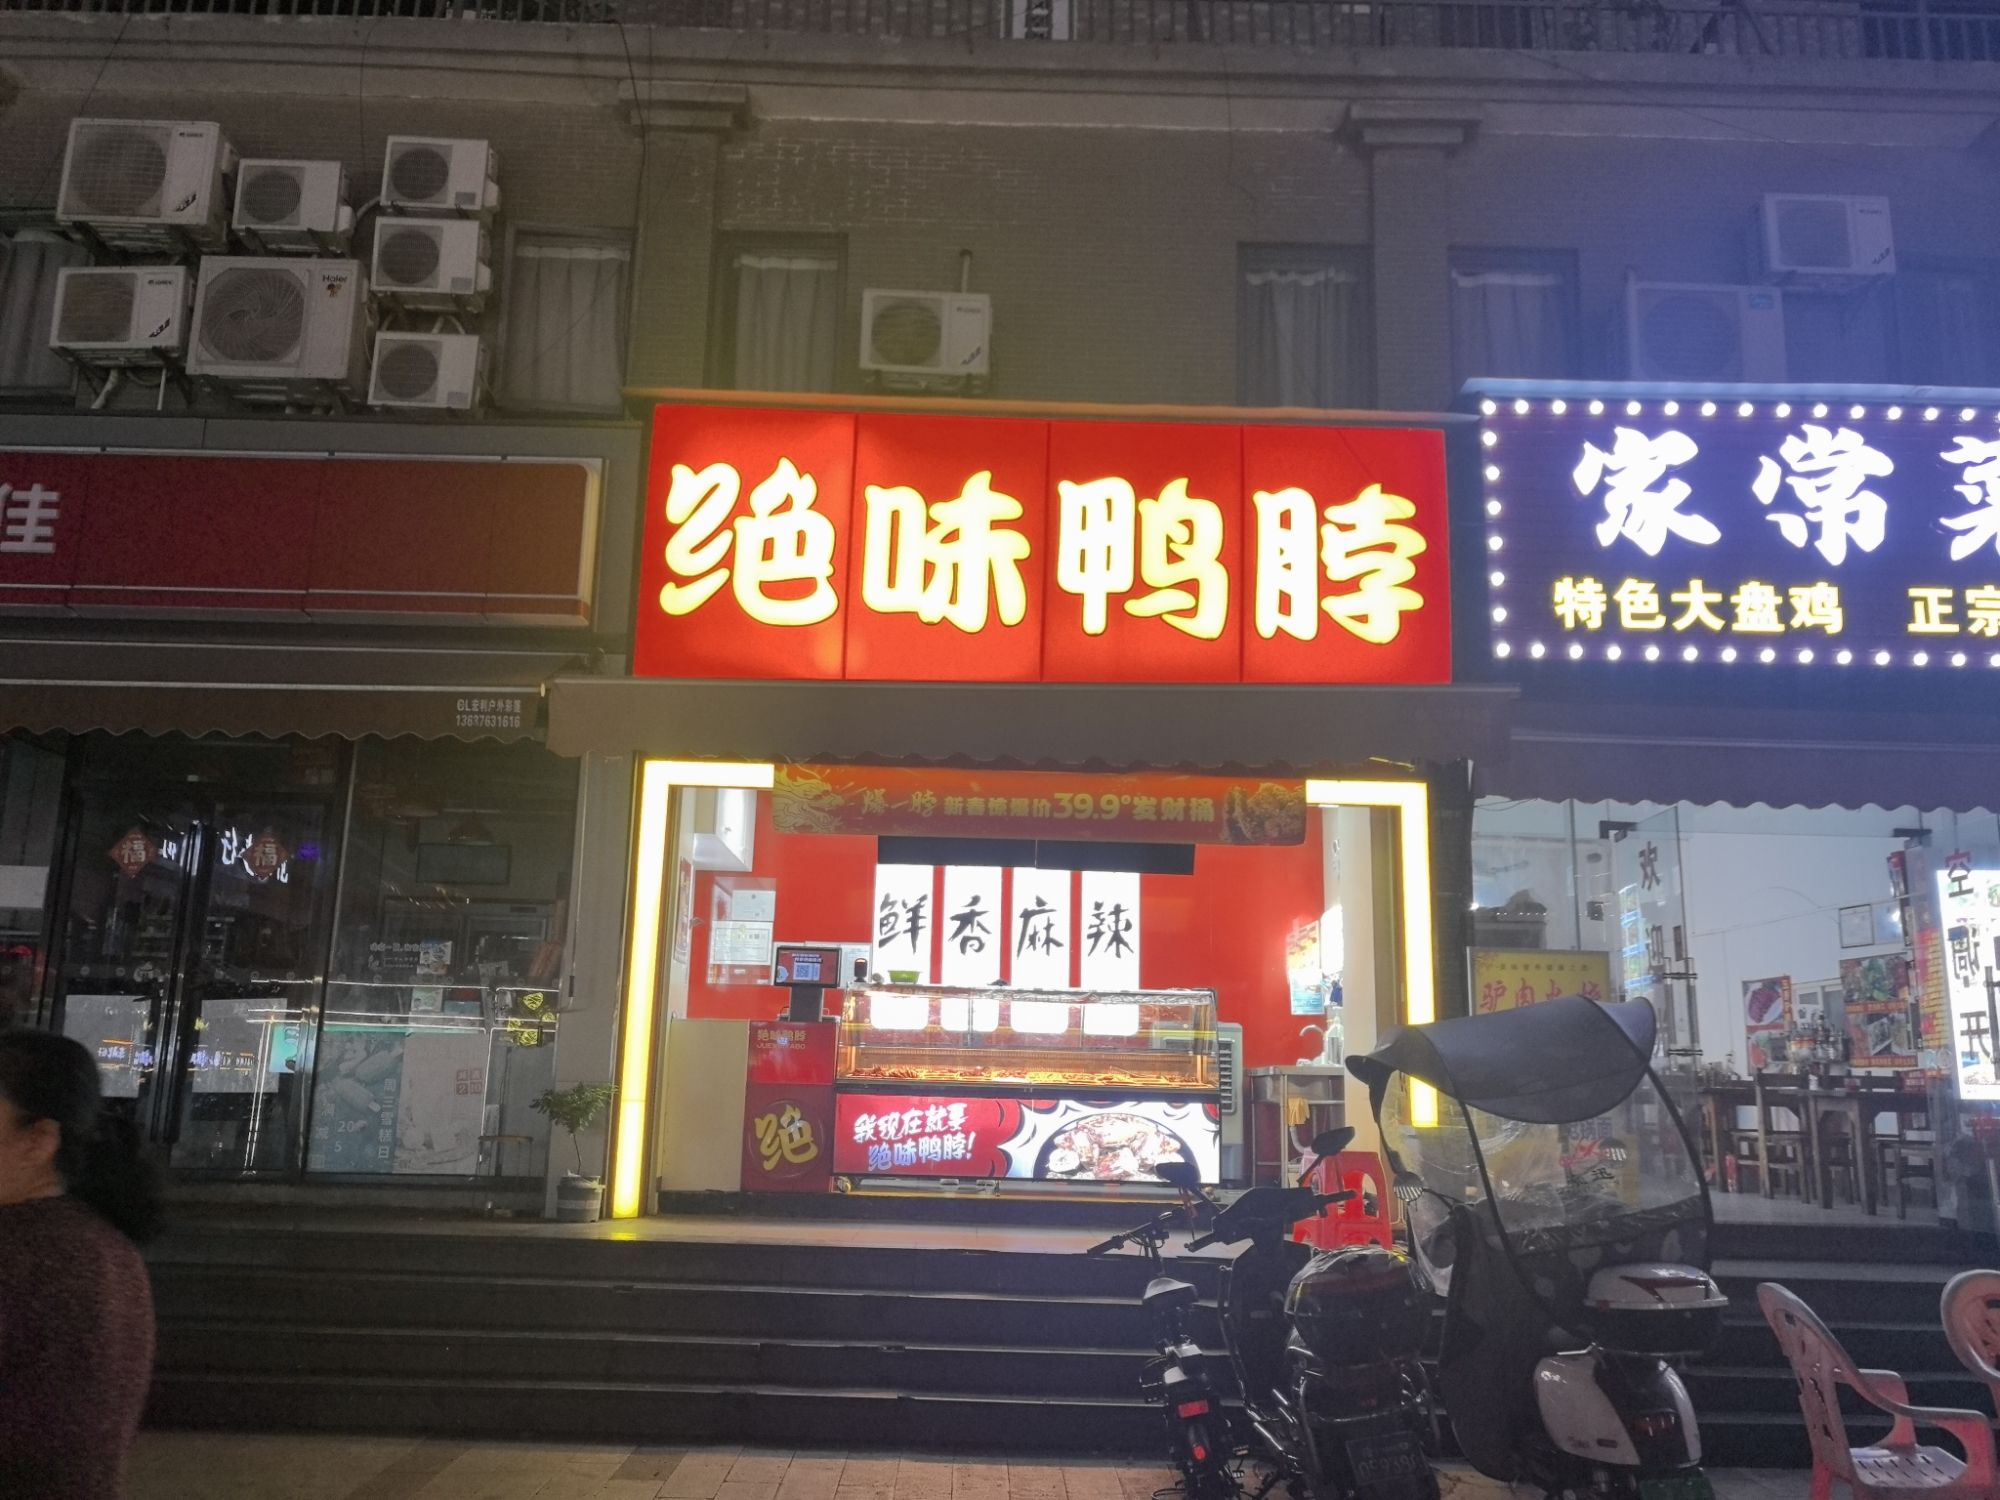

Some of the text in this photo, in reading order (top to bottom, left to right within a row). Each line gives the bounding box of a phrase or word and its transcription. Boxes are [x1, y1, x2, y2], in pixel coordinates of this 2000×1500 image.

[659, 456, 1427, 645] 绝味鸭脖
[1553, 577, 1844, 635] 特色大盘鸡
[878, 893, 1135, 959] 鲜香麻辣
[754, 1103, 819, 1171] 绝
